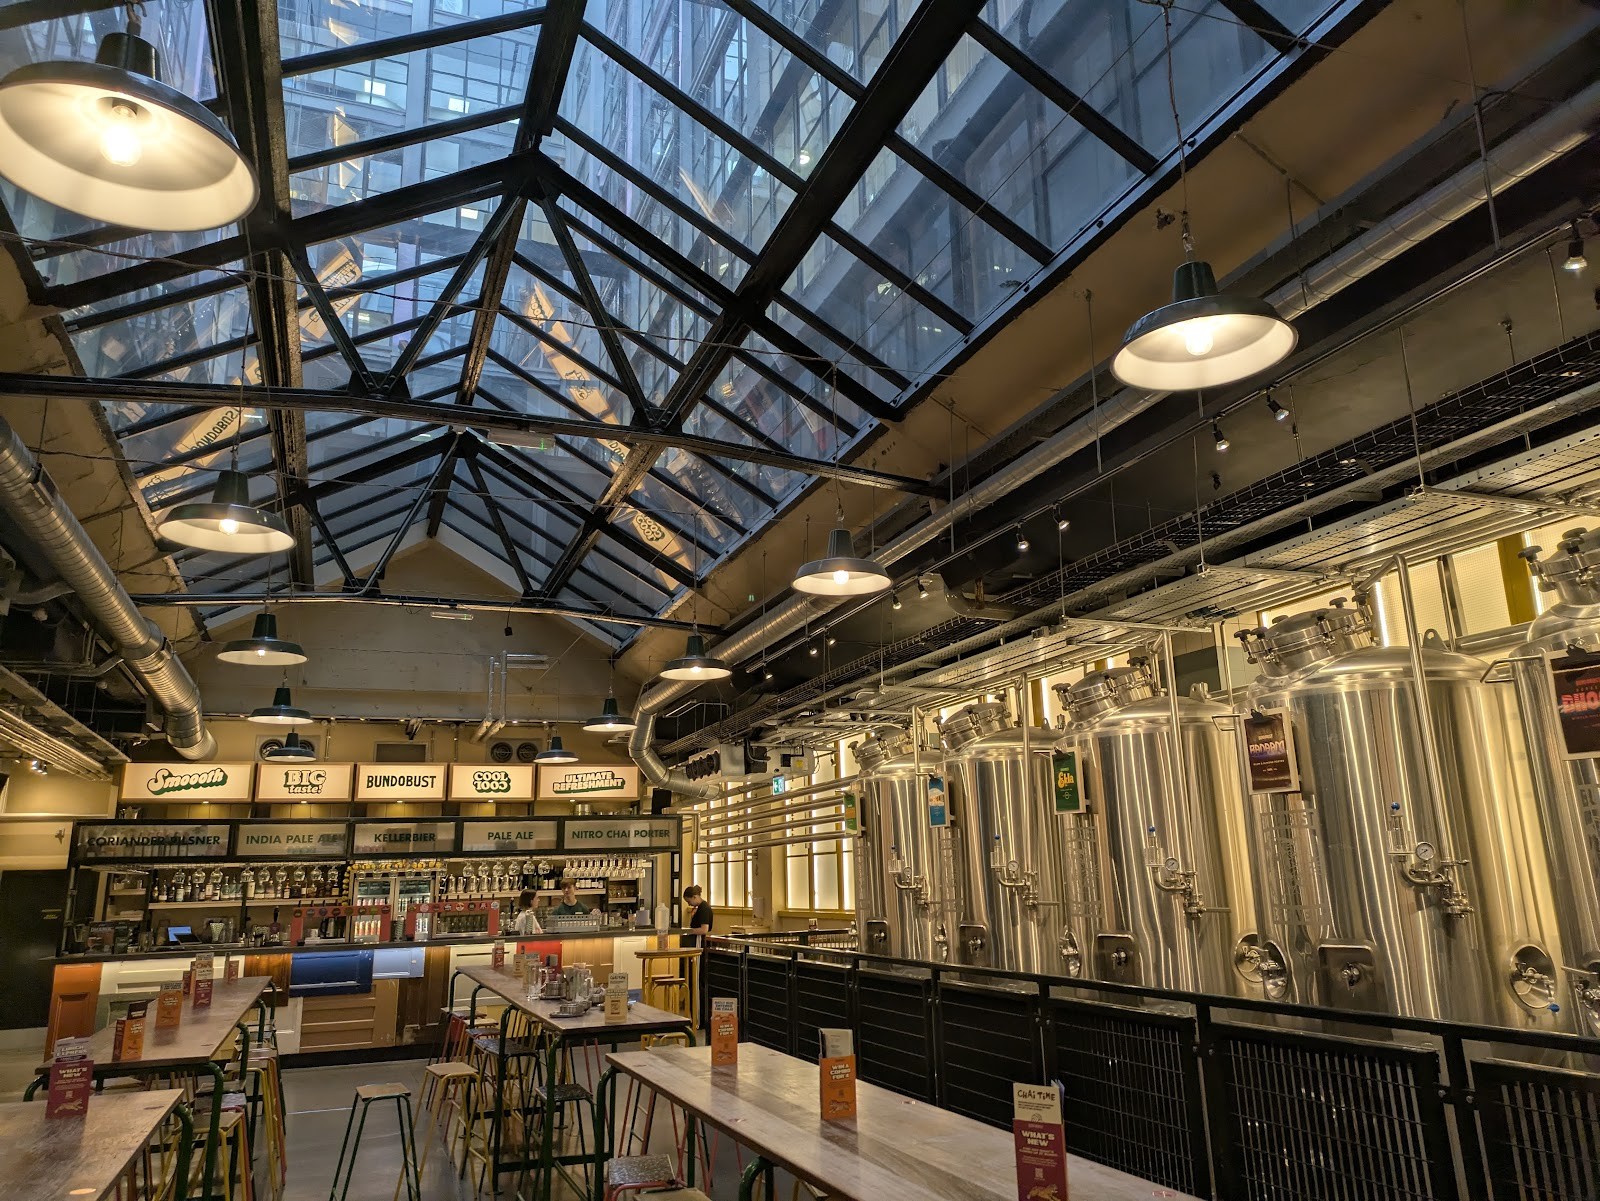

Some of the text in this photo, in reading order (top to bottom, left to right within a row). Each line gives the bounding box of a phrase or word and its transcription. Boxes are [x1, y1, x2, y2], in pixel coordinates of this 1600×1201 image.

[147, 768, 228, 795] Smoooth
[284, 769, 326, 787] BIG
[366, 774, 437, 789] BUNDOBUST
[473, 771, 509, 782] COOL
[565, 771, 615, 783] ULTIMATE
[288, 784, 323, 794] taste!
[553, 778, 625, 794] REFRESHMENT
[245, 835, 282, 845] INDIA
[286, 834, 314, 844] PALE
[374, 832, 436, 843] KELLERBIER
[487, 831, 534, 841] PALE ALE
[571, 829, 670, 839] NITRO CHAI PORTER
[87, 835, 166, 847] CORIANDER
[1021, 1130, 1055, 1141] WHAT'S
[1026, 1138, 1049, 1147] NEW
